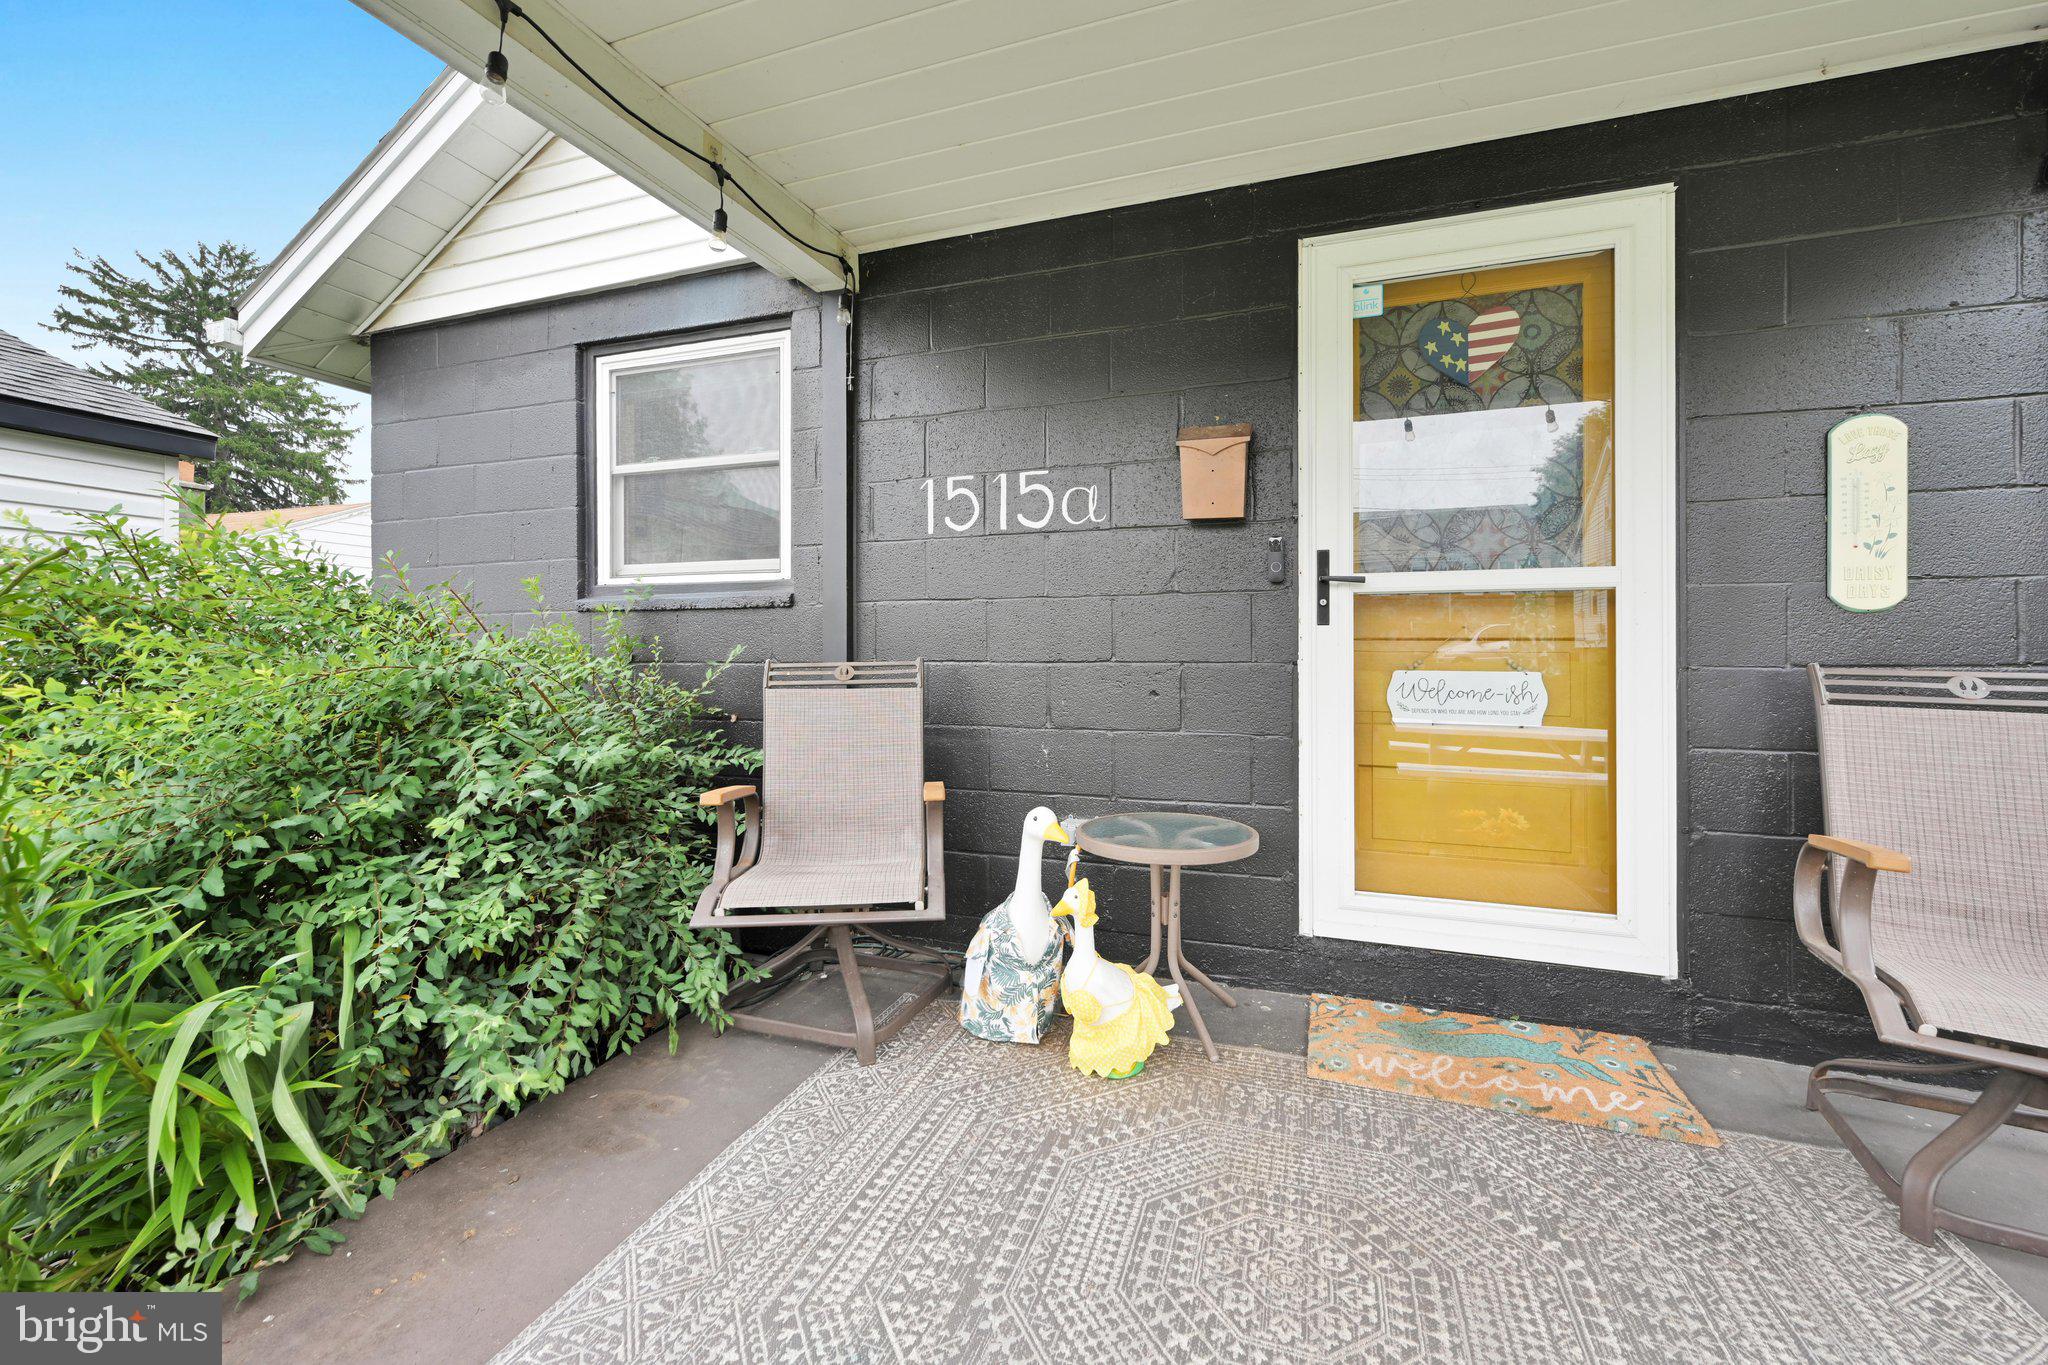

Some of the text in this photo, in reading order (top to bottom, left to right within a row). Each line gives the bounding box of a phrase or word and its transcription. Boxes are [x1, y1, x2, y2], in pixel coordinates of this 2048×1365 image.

[1843, 565, 1894, 581] DAISY
[1846, 583, 1890, 599] DAYS
[1395, 677, 1539, 705] Welcome-ish
[1357, 1053, 1643, 1112] welcome
